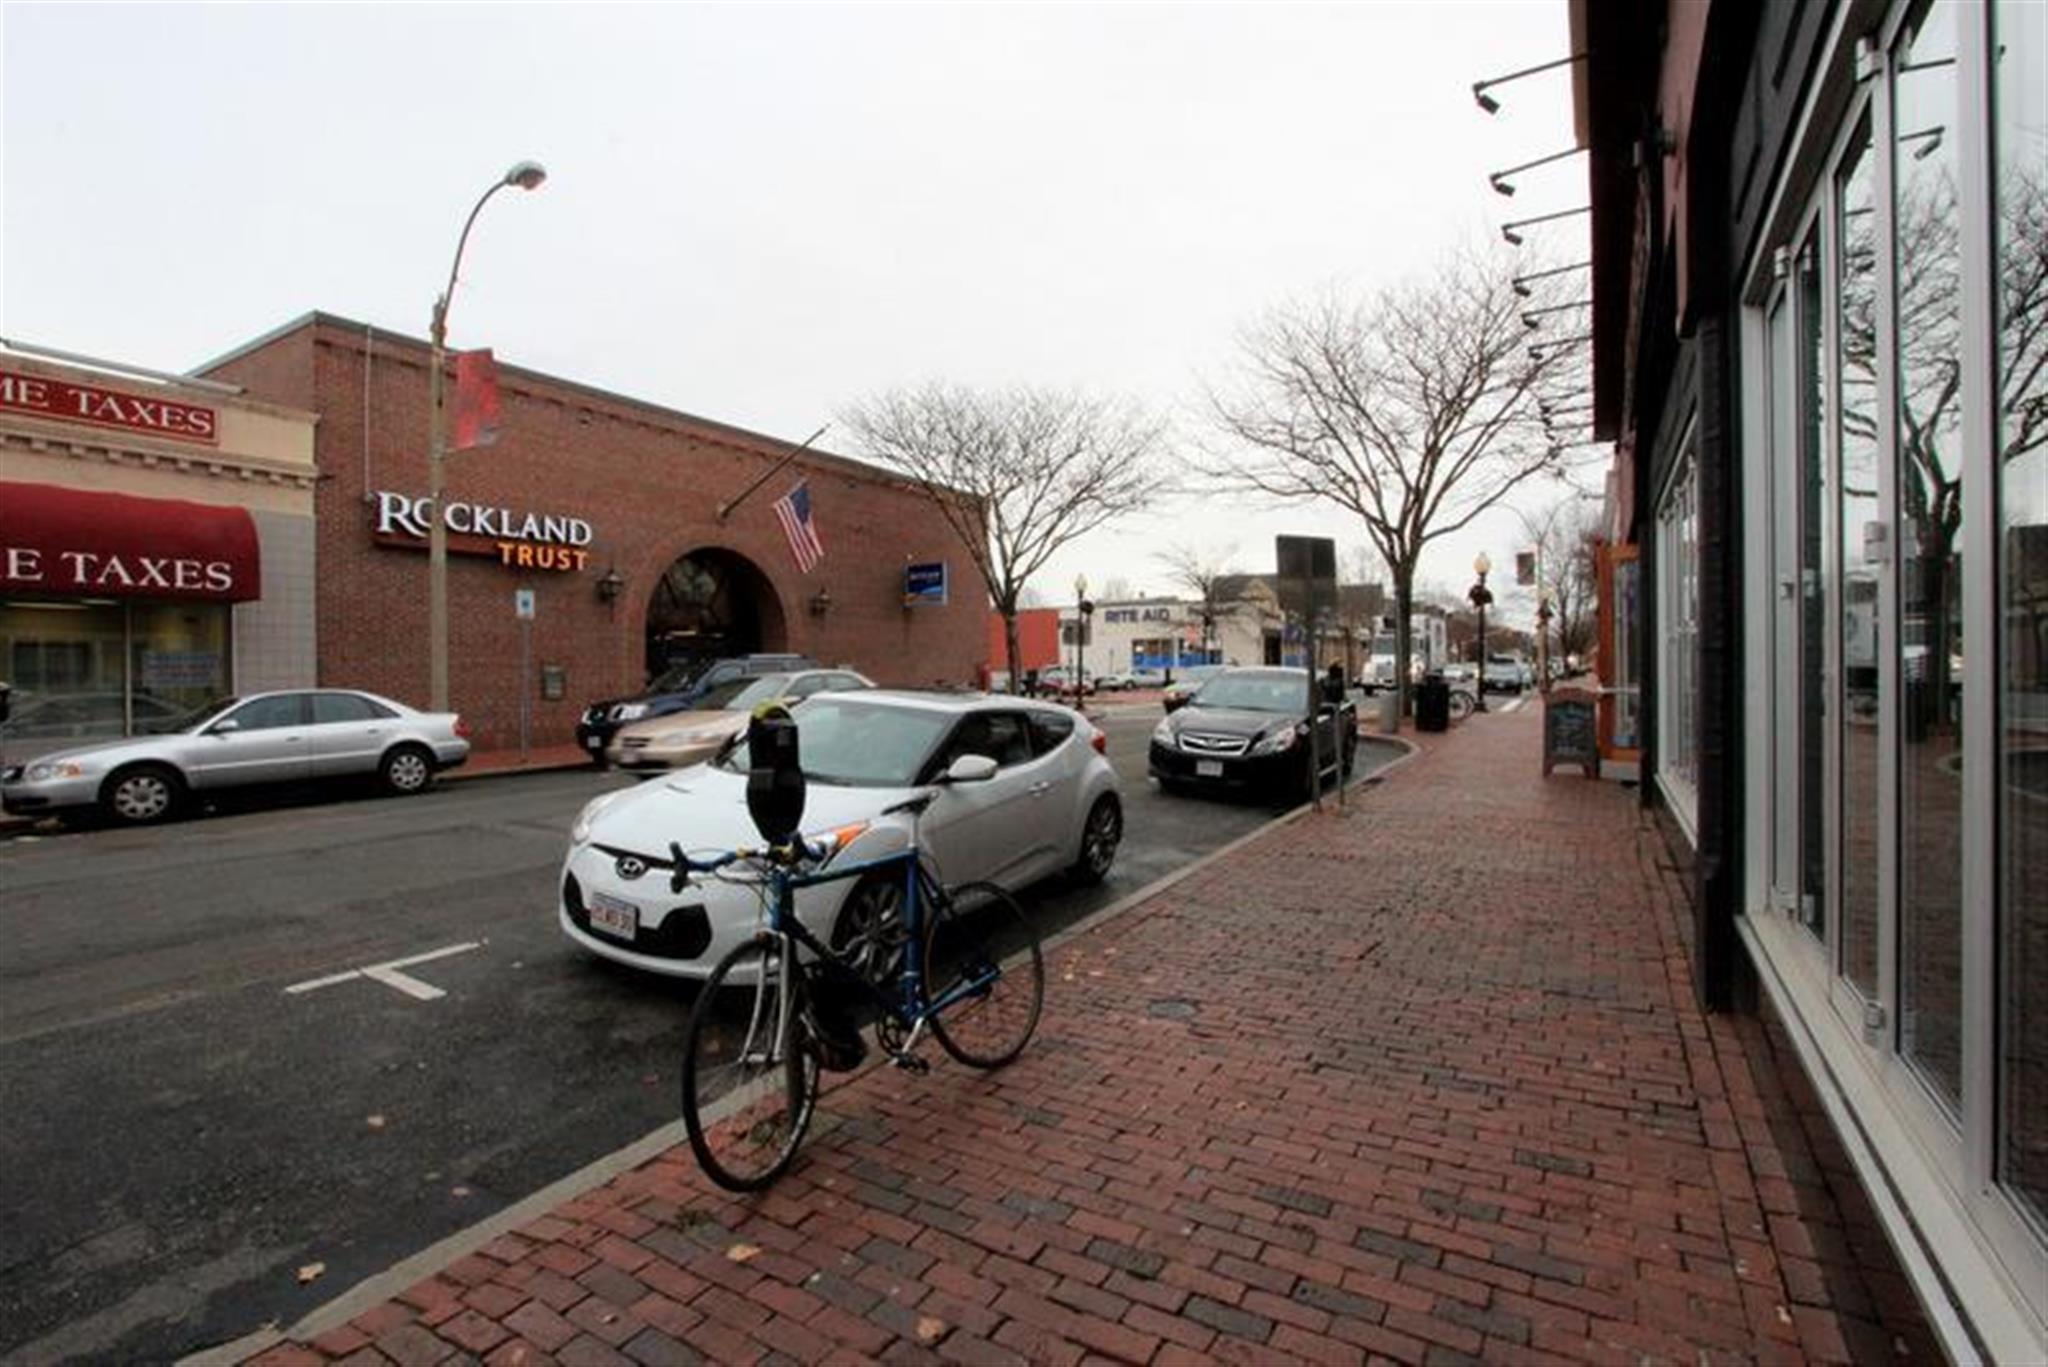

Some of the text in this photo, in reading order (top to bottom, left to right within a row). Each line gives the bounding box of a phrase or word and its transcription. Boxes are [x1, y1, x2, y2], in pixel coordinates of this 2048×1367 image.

[68, 388, 212, 434] TAXES
[377, 491, 592, 546] ROCKLAND
[61, 551, 233, 591] TAXES
[498, 542, 589, 570] TRUST
[1105, 608, 1170, 623] RITE AID
